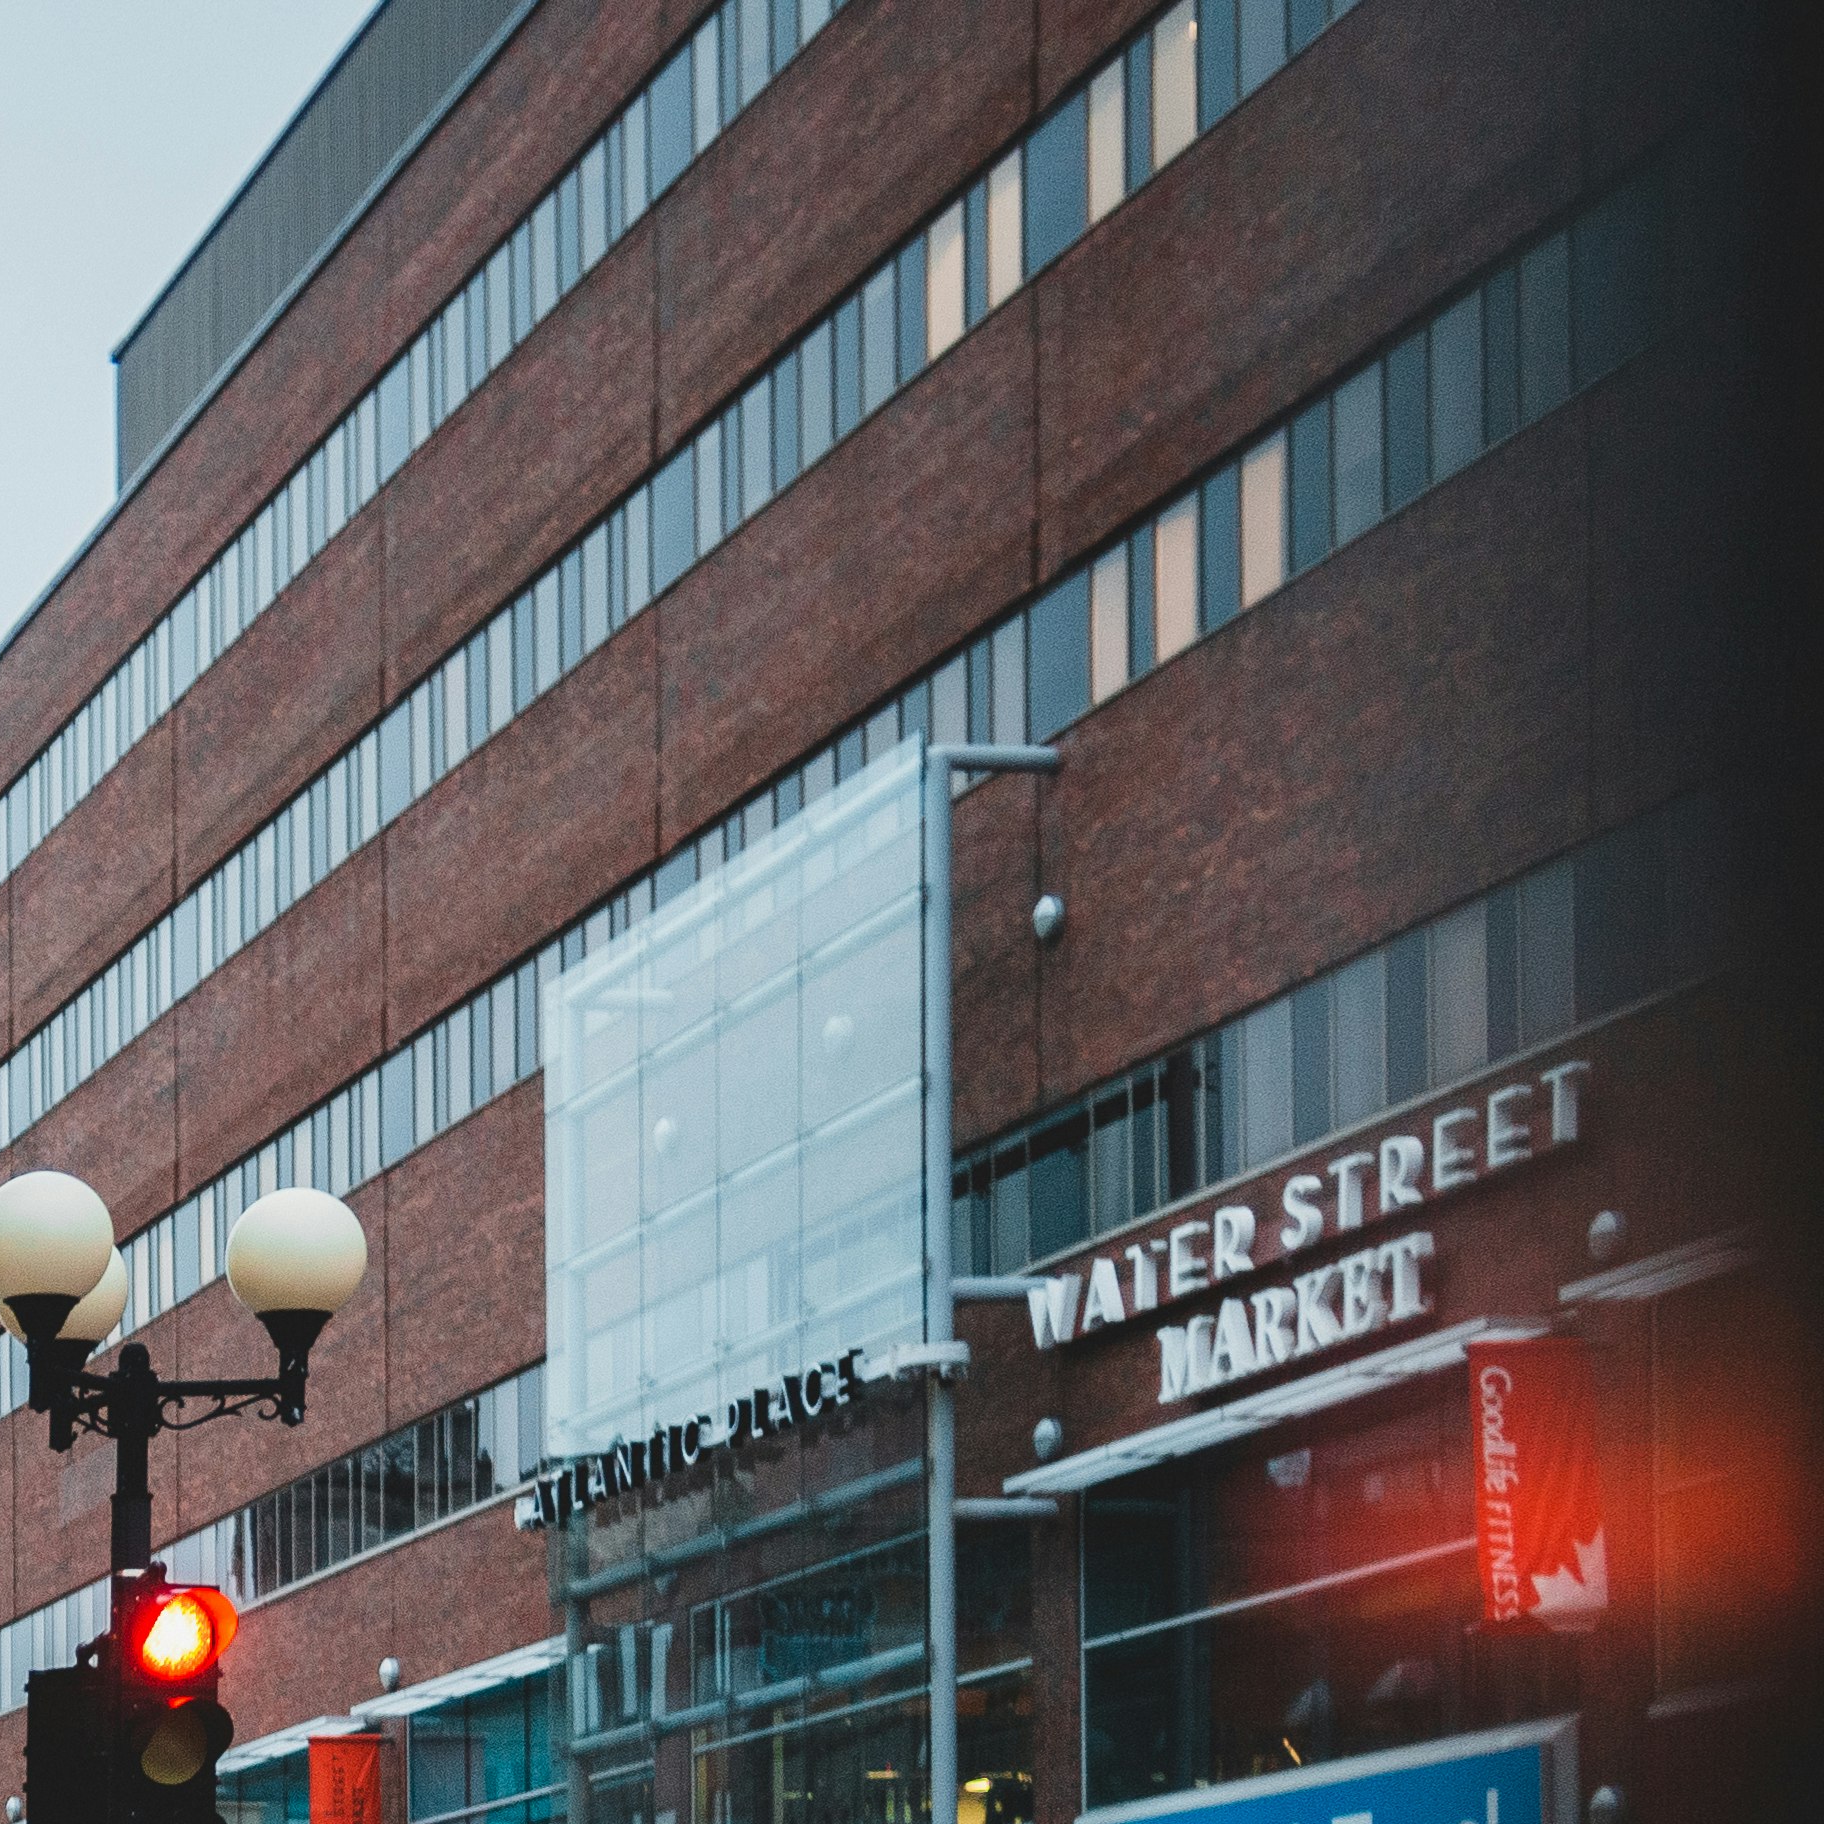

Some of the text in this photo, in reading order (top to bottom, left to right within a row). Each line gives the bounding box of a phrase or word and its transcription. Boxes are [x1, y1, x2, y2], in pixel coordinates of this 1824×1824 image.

[1028, 1060, 1591, 1350] WATER STREET
[1157, 1231, 1435, 1404] MARKET
[515, 1349, 863, 1530] ATLANTIC PLACE
[1486, 1499, 1521, 1622] FITNESS
